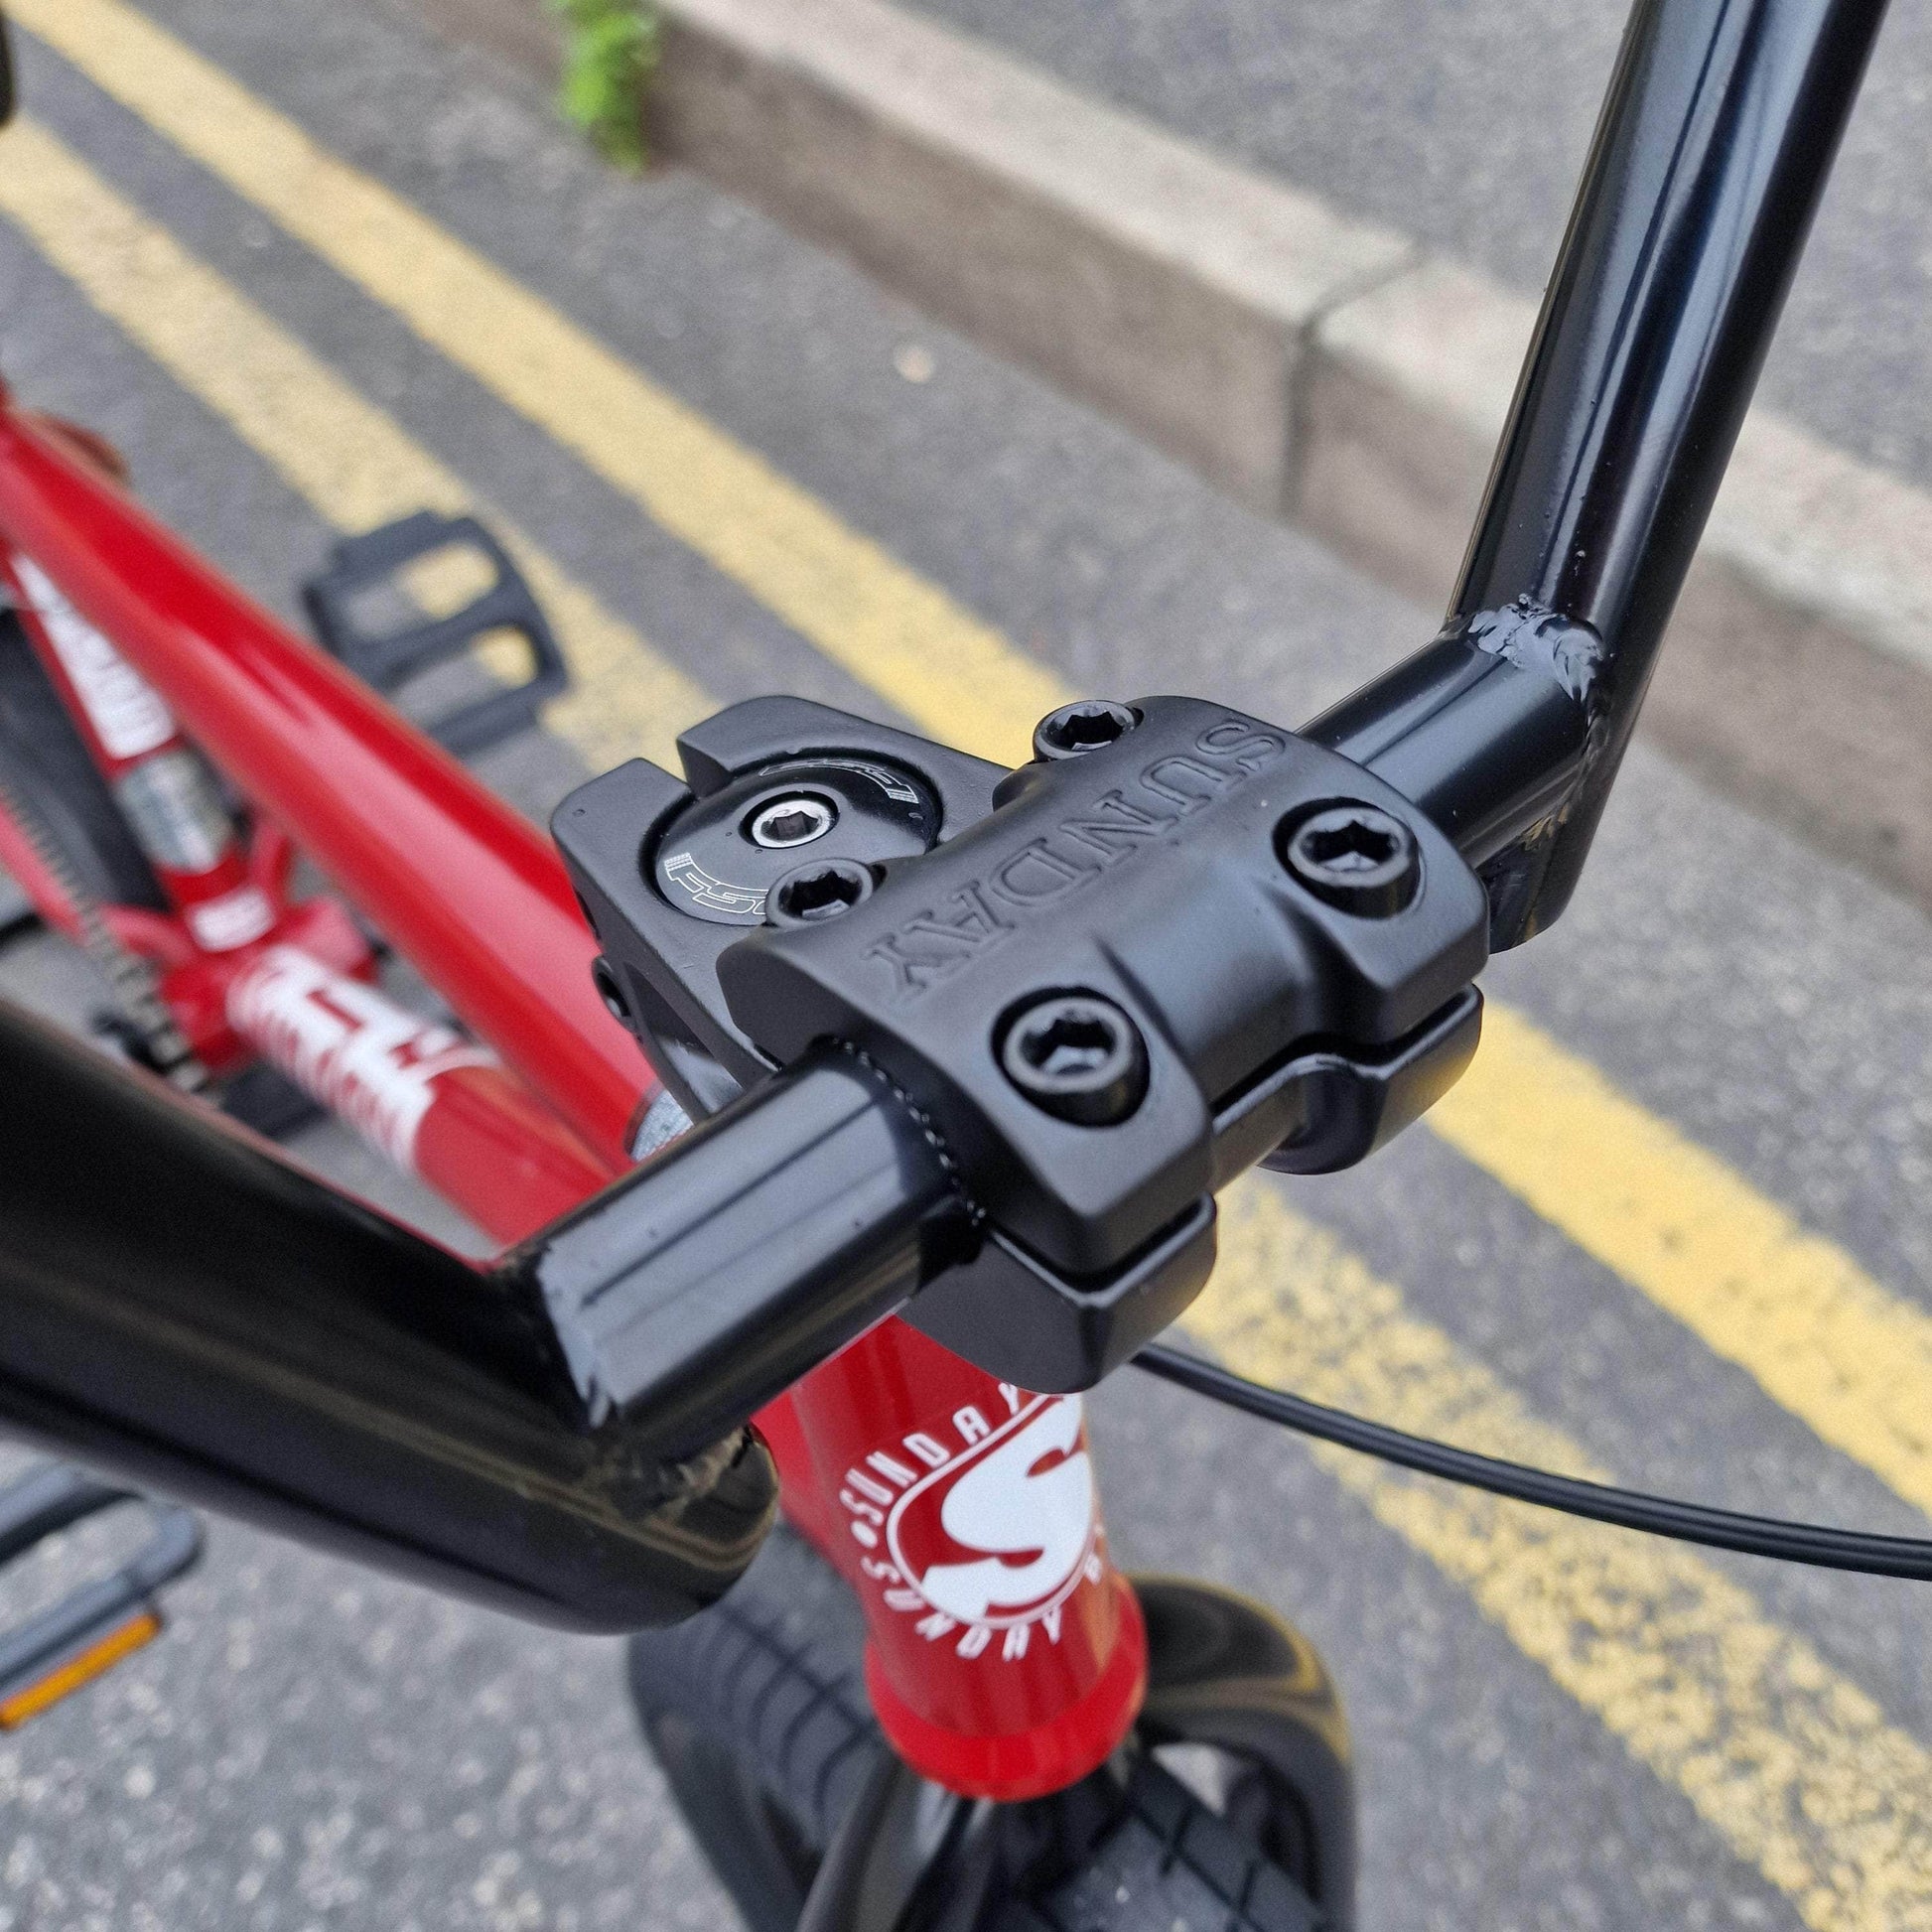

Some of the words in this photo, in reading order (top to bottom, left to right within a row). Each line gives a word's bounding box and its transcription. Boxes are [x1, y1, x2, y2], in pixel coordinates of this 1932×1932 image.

[663, 852, 768, 915] FS
[861, 717, 1287, 993] SUNDAY
[839, 1381, 1020, 1527] SUNDAY
[860, 1556, 1062, 1662] SUNDAY
